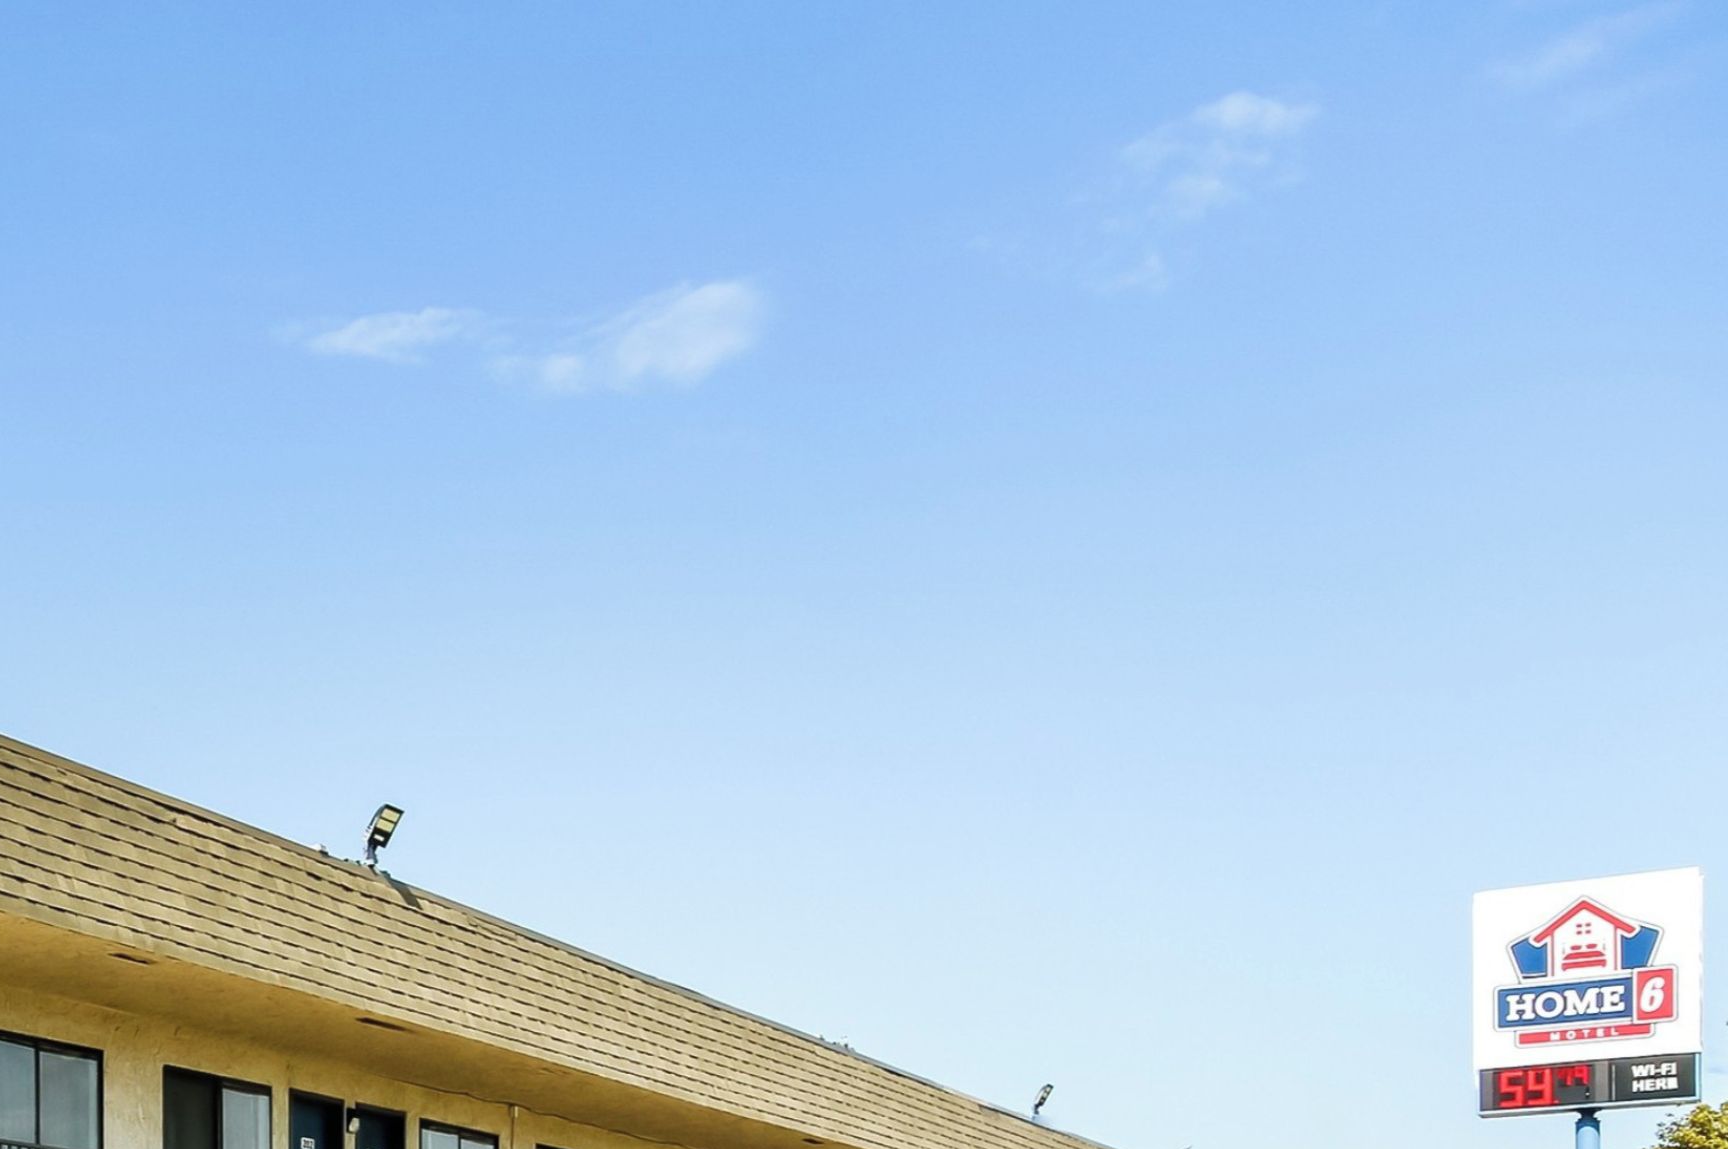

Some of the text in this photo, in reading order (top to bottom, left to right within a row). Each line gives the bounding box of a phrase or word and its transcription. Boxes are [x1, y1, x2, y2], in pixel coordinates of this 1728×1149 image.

[1505, 976, 1665, 1022] HOME 6
[1550, 1027, 1620, 1042] MOTEL
